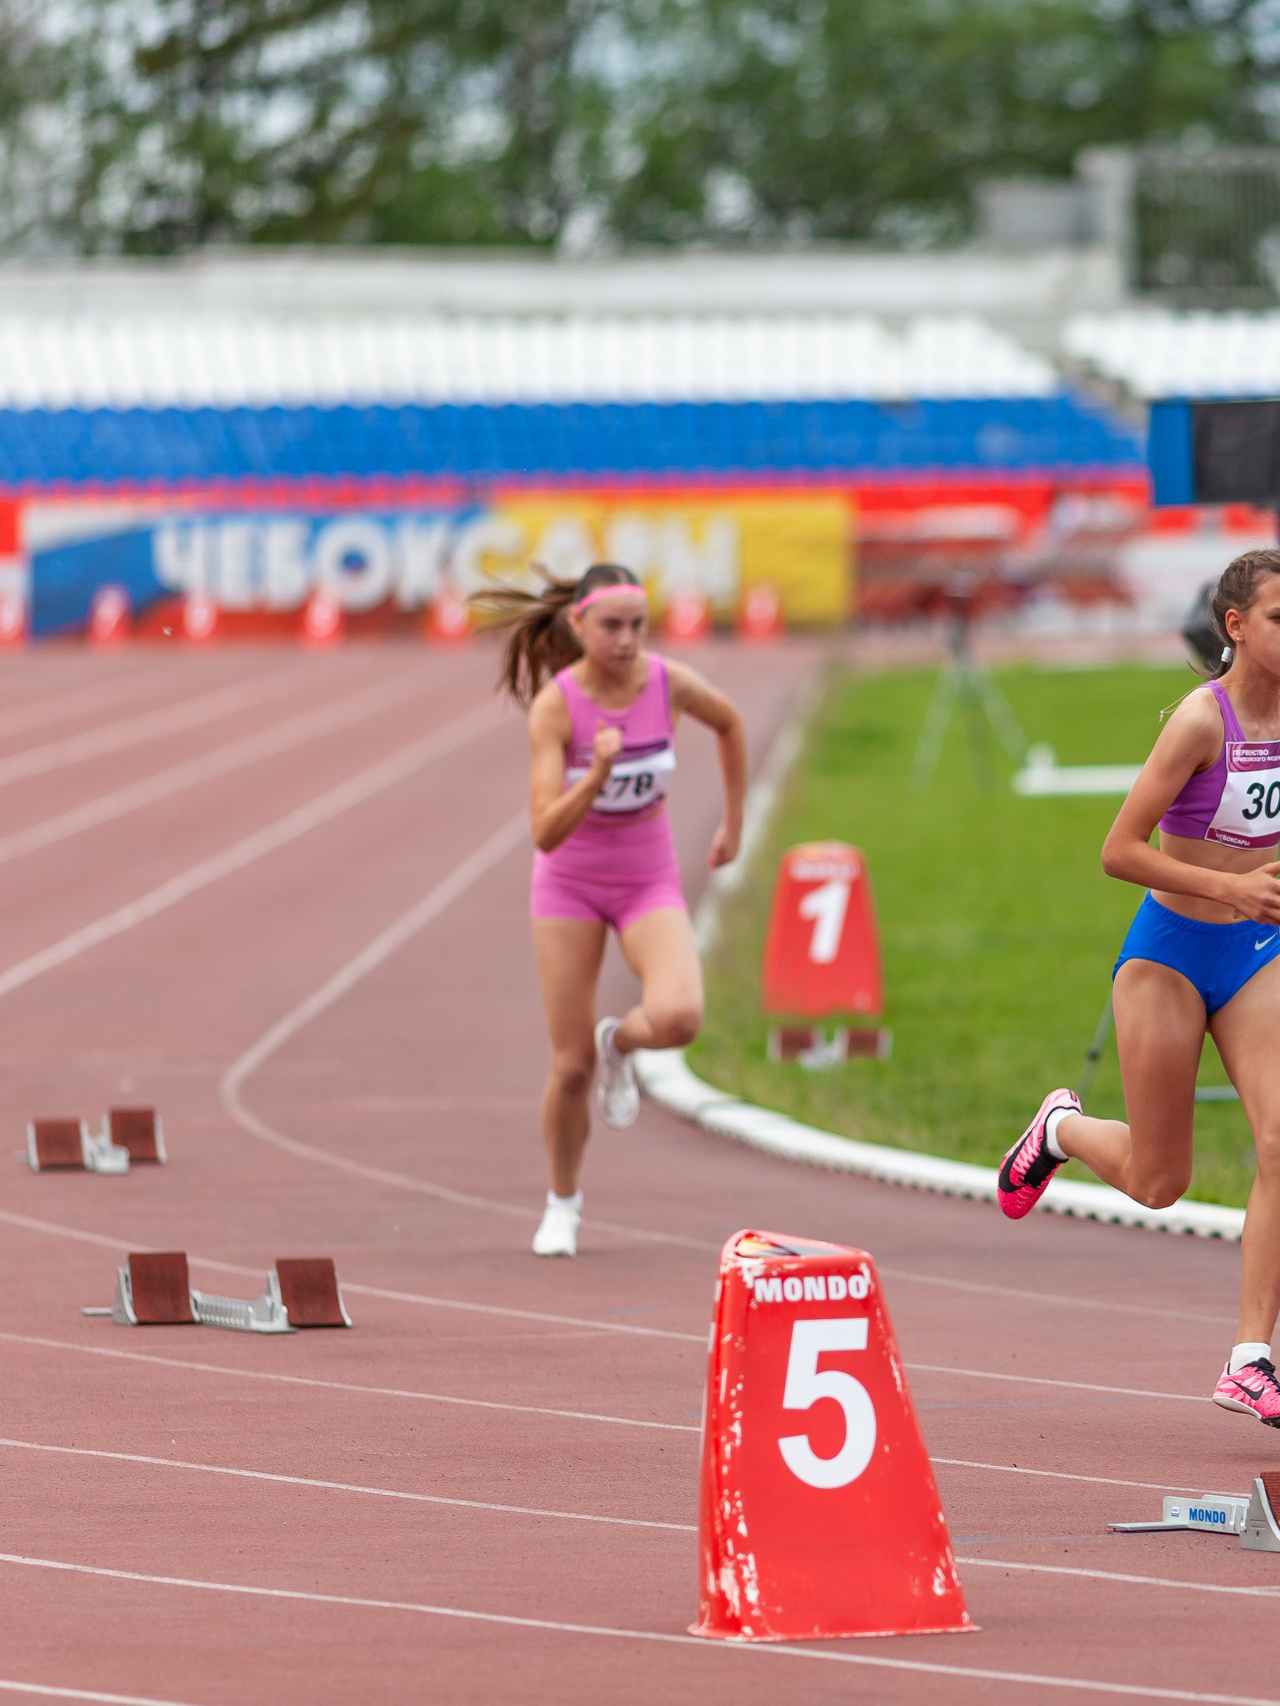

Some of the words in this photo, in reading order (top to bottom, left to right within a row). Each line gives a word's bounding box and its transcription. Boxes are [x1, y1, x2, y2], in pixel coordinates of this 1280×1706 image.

[599, 772, 653, 799] 78
[798, 879, 851, 964] 1
[754, 1275, 869, 1303] MONDO
[778, 1317, 877, 1490] 5
[1189, 1507, 1226, 1525] MONDO
